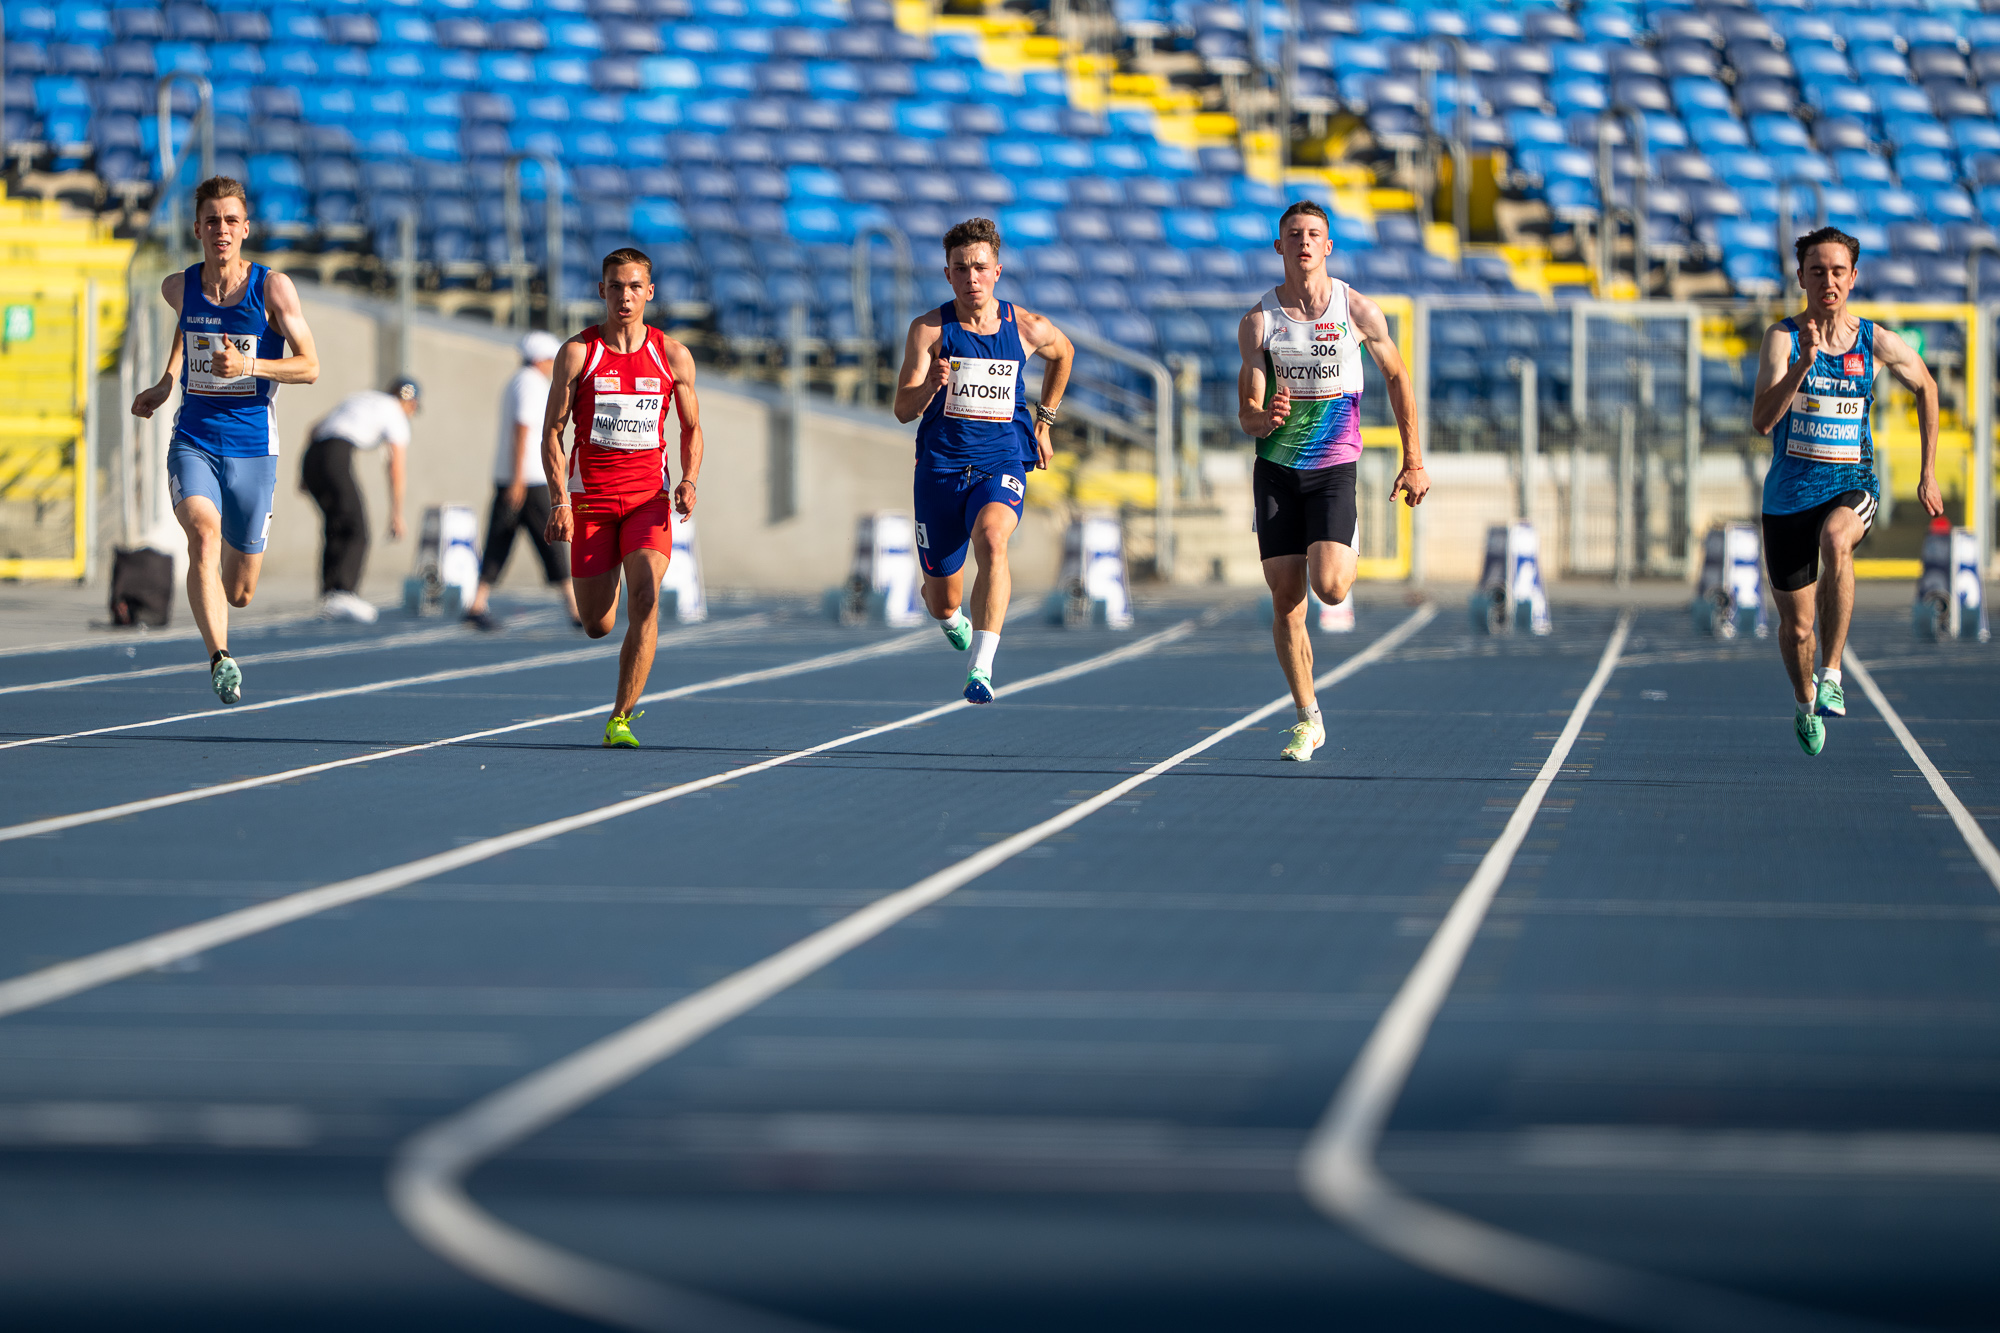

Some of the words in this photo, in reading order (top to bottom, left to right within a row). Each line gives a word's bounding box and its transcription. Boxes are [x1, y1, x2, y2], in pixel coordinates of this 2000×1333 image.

[1315, 322, 1335, 330] MKS
[1310, 344, 1337, 357] 306
[988, 363, 1013, 377] 632
[1275, 363, 1340, 380] BUCZYŃSKI
[951, 382, 1011, 400] LATOSIK
[1807, 374, 1857, 392] VECTRA
[635, 398, 659, 411] 478
[1835, 402, 1859, 415] 105
[595, 415, 658, 434] NAWOTCZYŃSKI
[1791, 418, 1860, 441] BAJRASZEWSKI
[1007, 477, 1020, 492] 5
[917, 525, 925, 545] 5
